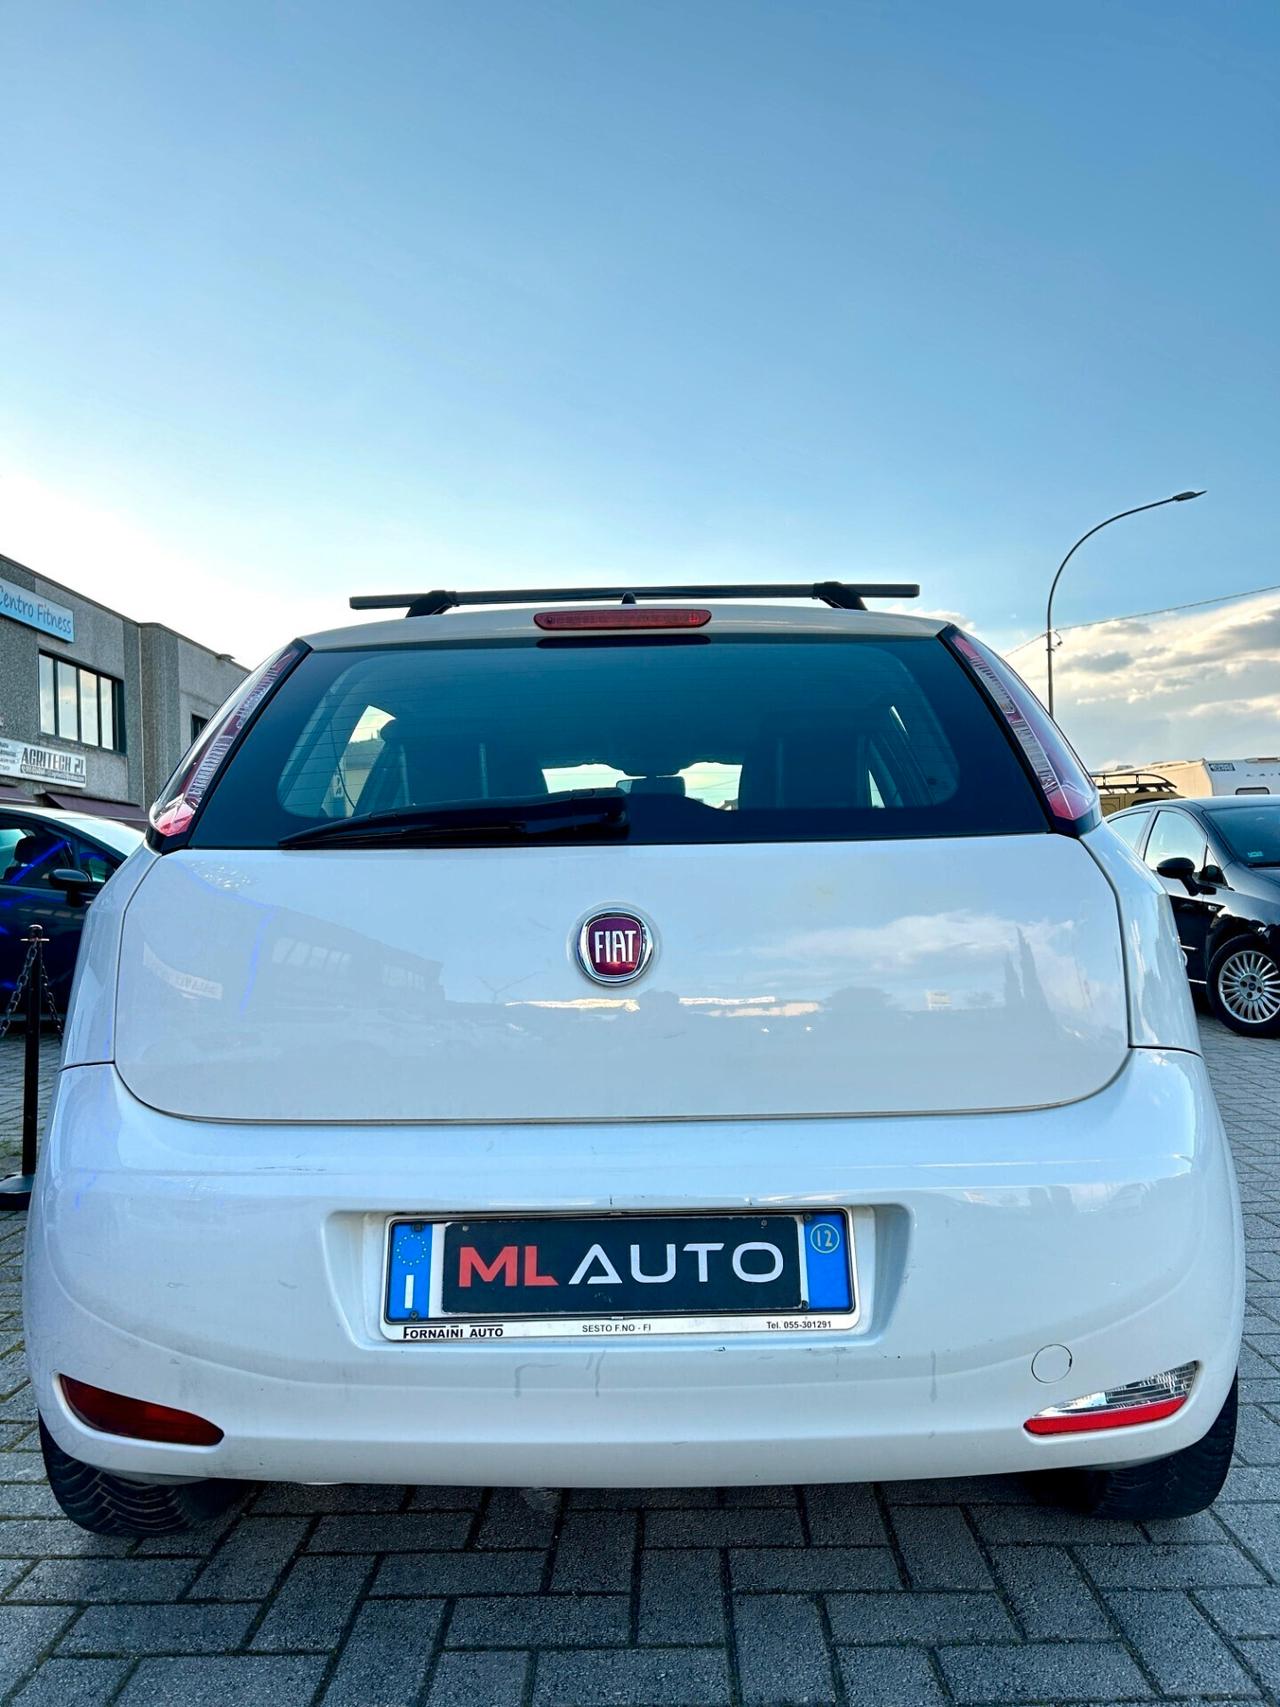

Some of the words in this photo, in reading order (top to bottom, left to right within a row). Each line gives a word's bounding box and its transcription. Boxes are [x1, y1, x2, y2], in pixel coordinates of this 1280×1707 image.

[37, 603, 72, 634] Fitness
[21, 747, 72, 772] AGRITECH
[594, 930, 637, 963] FIAT
[816, 1229, 833, 1247] 12
[458, 1245, 560, 1288] ML
[568, 1241, 784, 1285] AUTO
[403, 1325, 464, 1339] FORNAINI
[469, 1327, 504, 1338] AUTO
[582, 1324, 613, 1333] SESTO
[766, 1320, 782, 1330] Tel.
[783, 1319, 832, 1329] 055-301291
